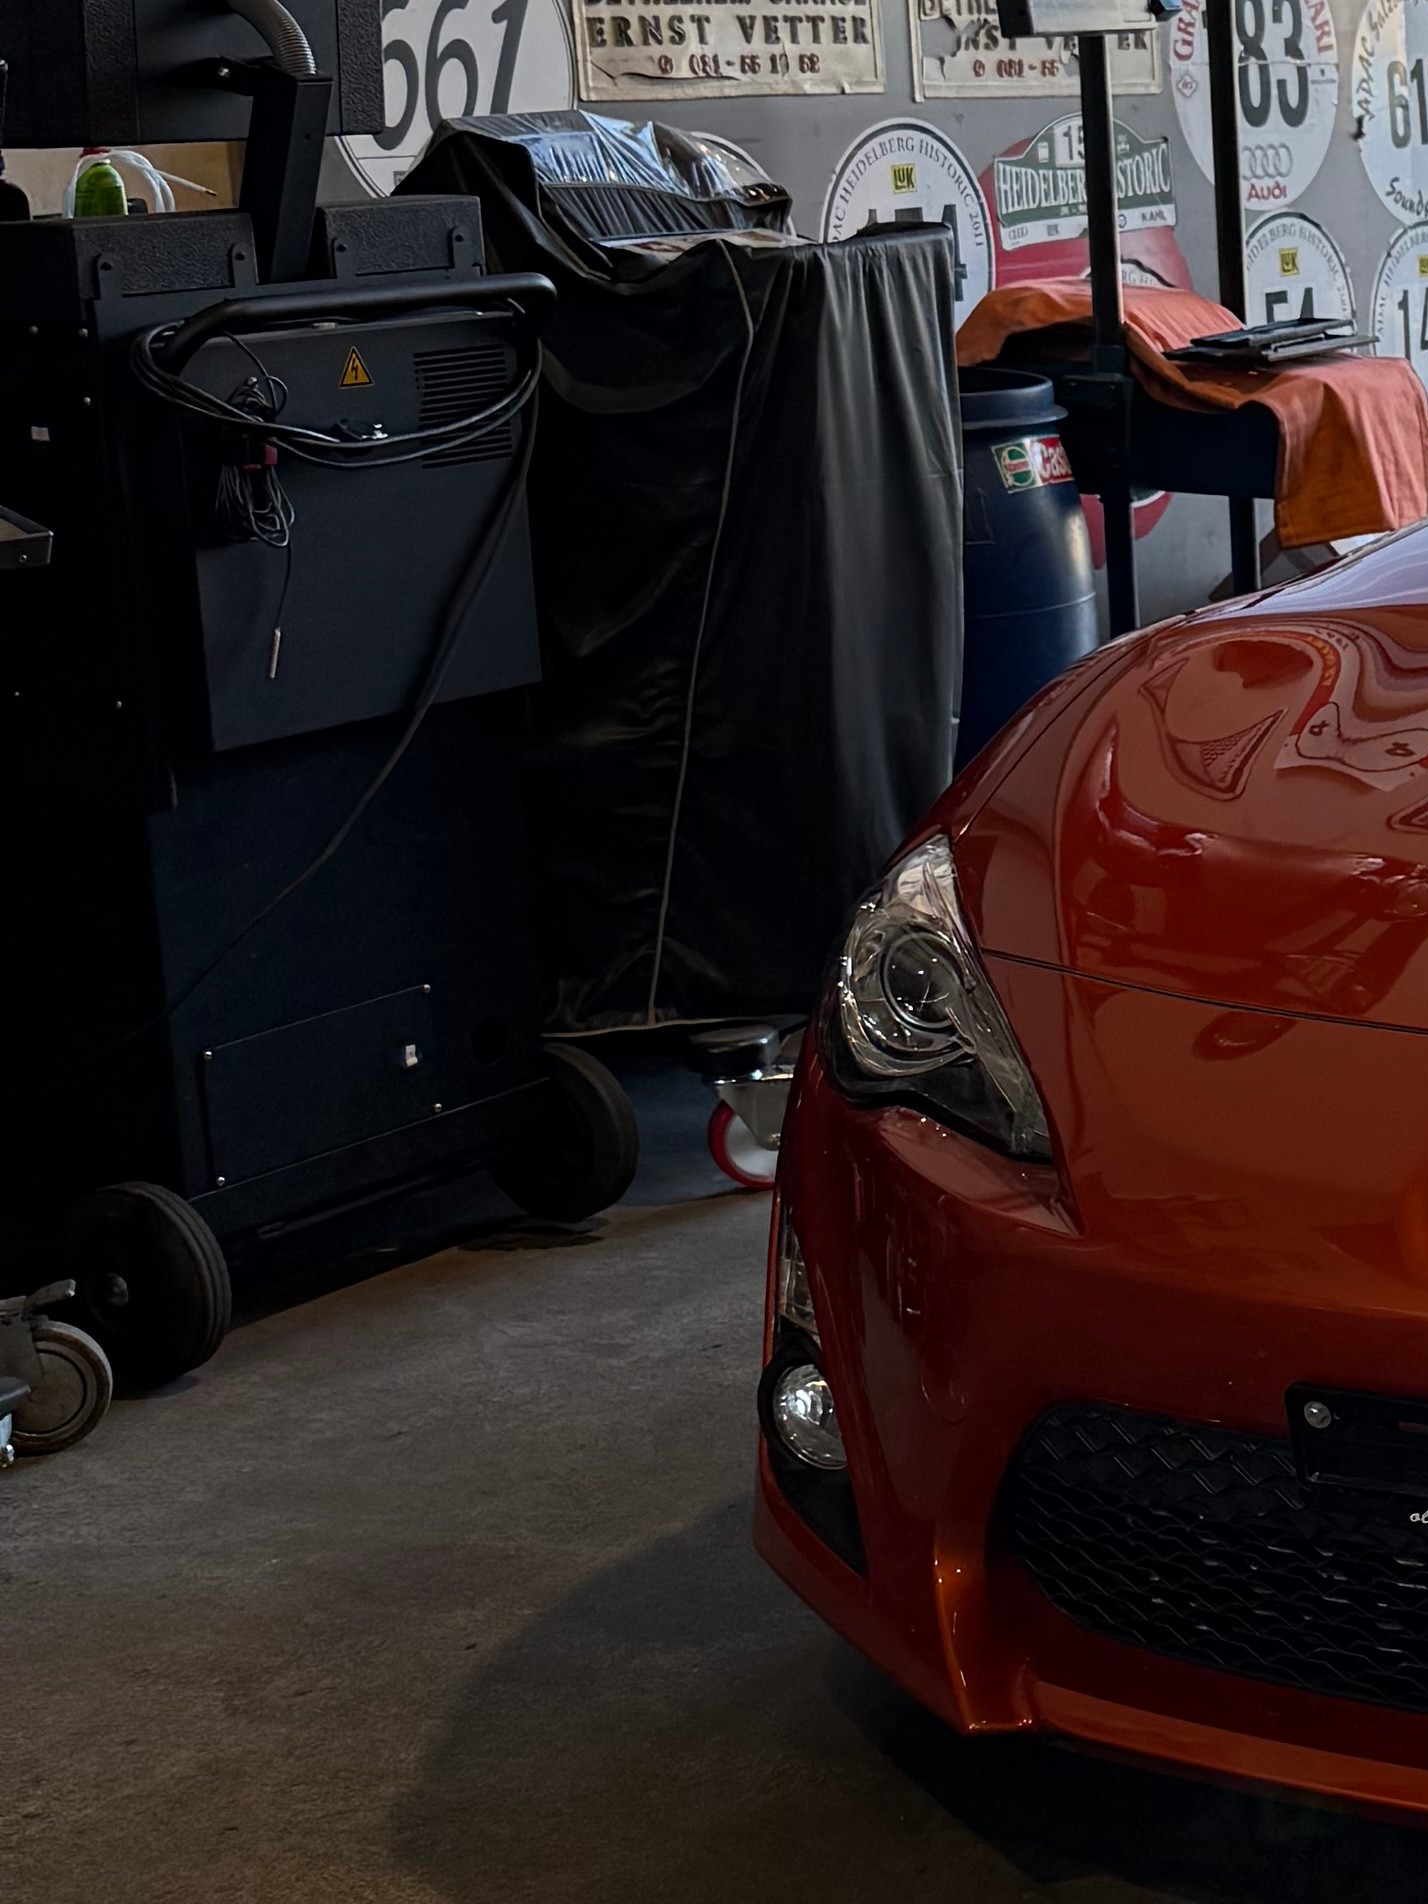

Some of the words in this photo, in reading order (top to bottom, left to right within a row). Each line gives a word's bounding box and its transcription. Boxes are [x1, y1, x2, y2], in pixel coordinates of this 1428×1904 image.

[586, 14, 711, 48] ERNST
[735, 13, 871, 46] VETTER
[839, 137, 916, 206] HEIDELBERG
[919, 138, 977, 208] HISTORIC
[968, 209, 985, 247] 2011
[999, 161, 1087, 215] HEIDELBER
[1115, 143, 1172, 199] STORIC
[1247, 182, 1288, 202] Audi
